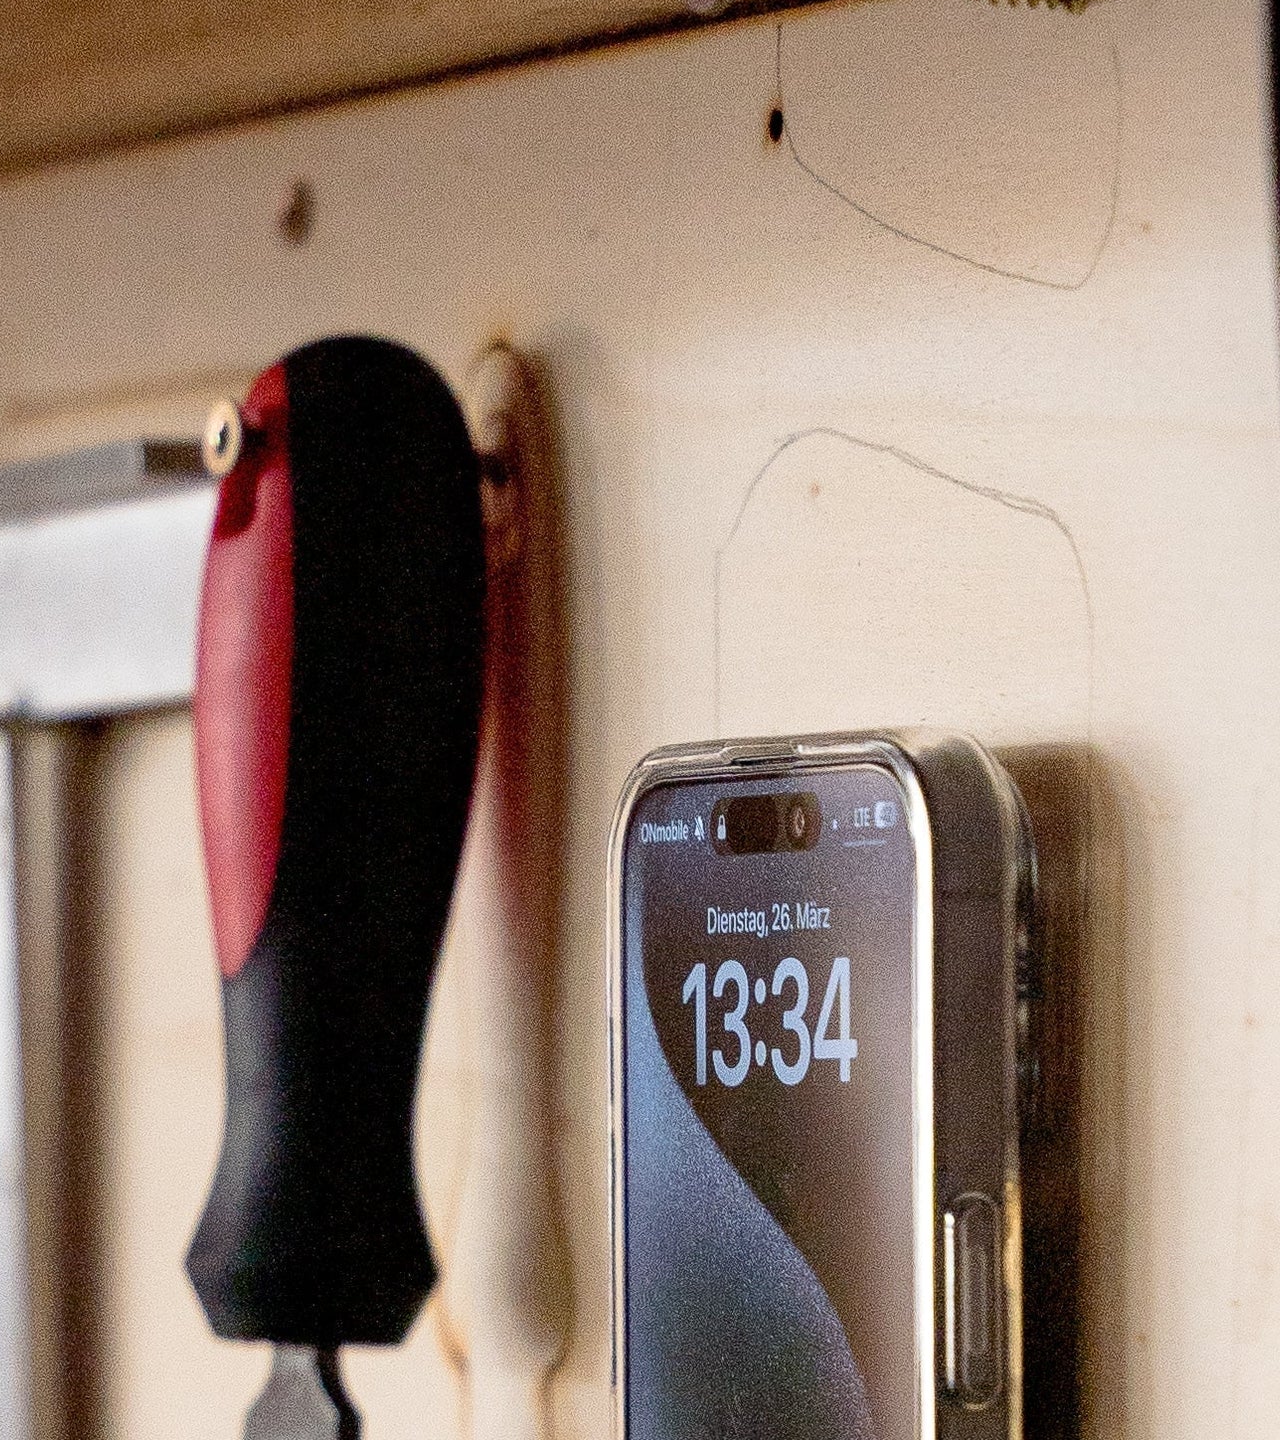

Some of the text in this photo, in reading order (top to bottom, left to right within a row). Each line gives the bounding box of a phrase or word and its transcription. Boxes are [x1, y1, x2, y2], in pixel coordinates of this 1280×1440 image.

[707, 901, 831, 938] Dienstag, 26. März
[682, 957, 858, 1086] 13:34
